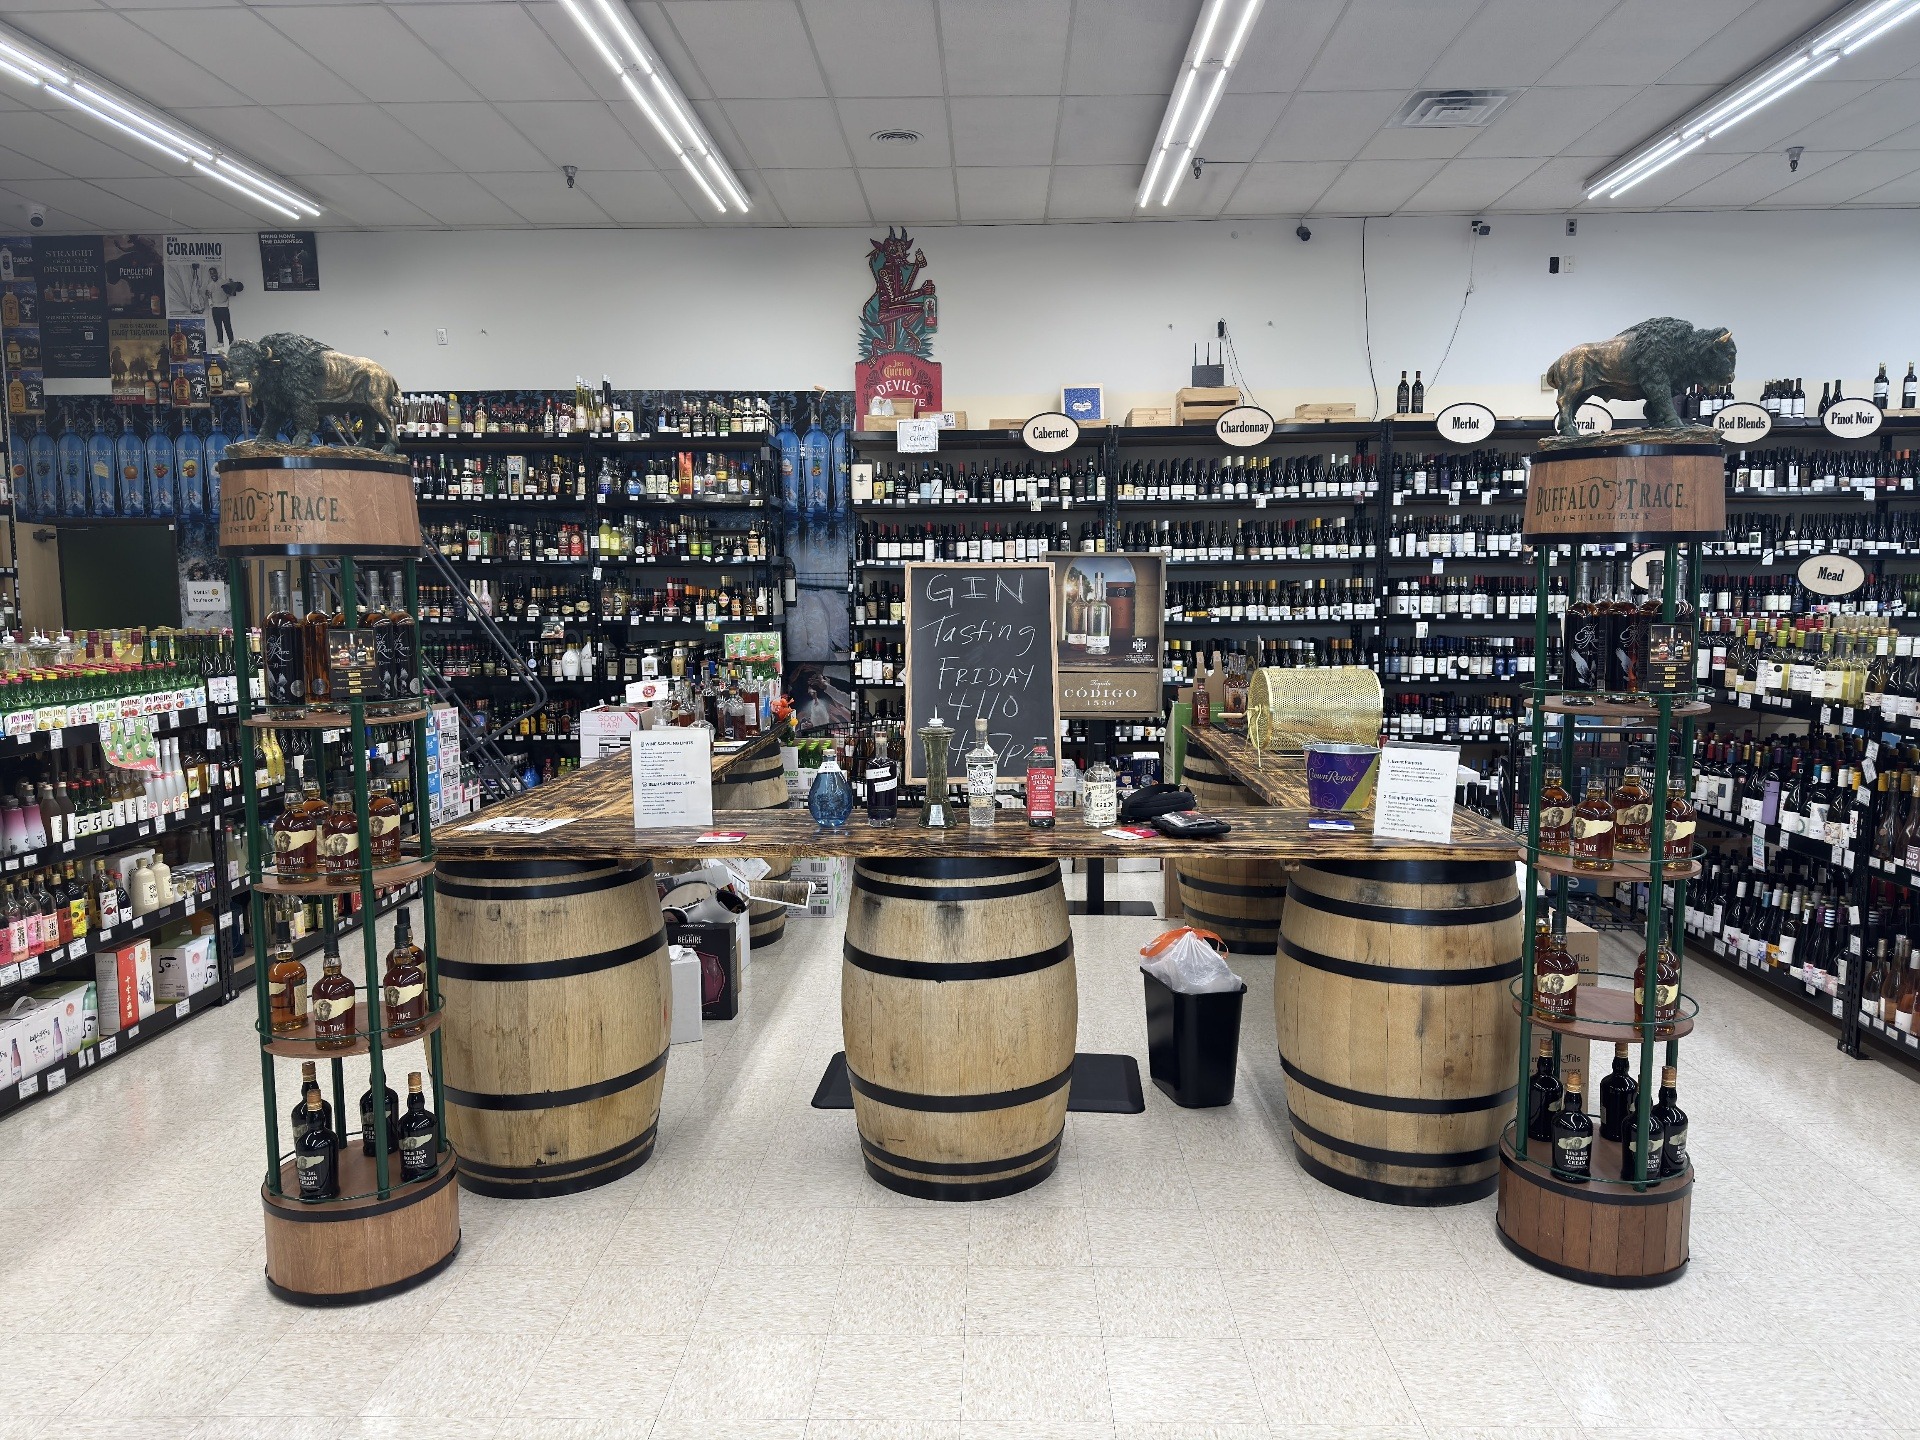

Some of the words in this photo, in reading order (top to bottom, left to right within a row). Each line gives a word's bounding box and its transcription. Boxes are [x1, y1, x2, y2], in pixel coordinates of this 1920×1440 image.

[45, 250, 94, 258] STRAIGHT
[167, 242, 222, 256] CORAMINO
[43, 266, 98, 274] DISTILLERY
[119, 268, 153, 276] PENDLETON
[884, 365, 912, 378] Cuervo
[876, 380, 922, 396] DEVIL'S
[1452, 416, 1480, 430] Merlot
[1718, 417, 1735, 429] Red
[1736, 416, 1766, 429] Blends
[1830, 412, 1854, 425] Pinot
[1855, 412, 1875, 425] Noir
[1032, 426, 1069, 440] Cabernet
[1220, 420, 1269, 434] Chardonnay
[1536, 483, 1600, 516] BUFFALO
[1625, 478, 1684, 510] TRACE
[276, 490, 339, 523] TRACE
[1552, 512, 1652, 524] DISTILLERY
[1817, 568, 1845, 582] Mead
[926, 574, 1024, 608] GIN
[916, 612, 1036, 656] Tasting
[938, 656, 1035, 692] FRIDAY
[1064, 688, 1138, 699] CÓDIGO
[1309, 768, 1328, 781] Crown
[1328, 769, 1358, 785] Royal
[290, 856, 304, 864] TRACE
